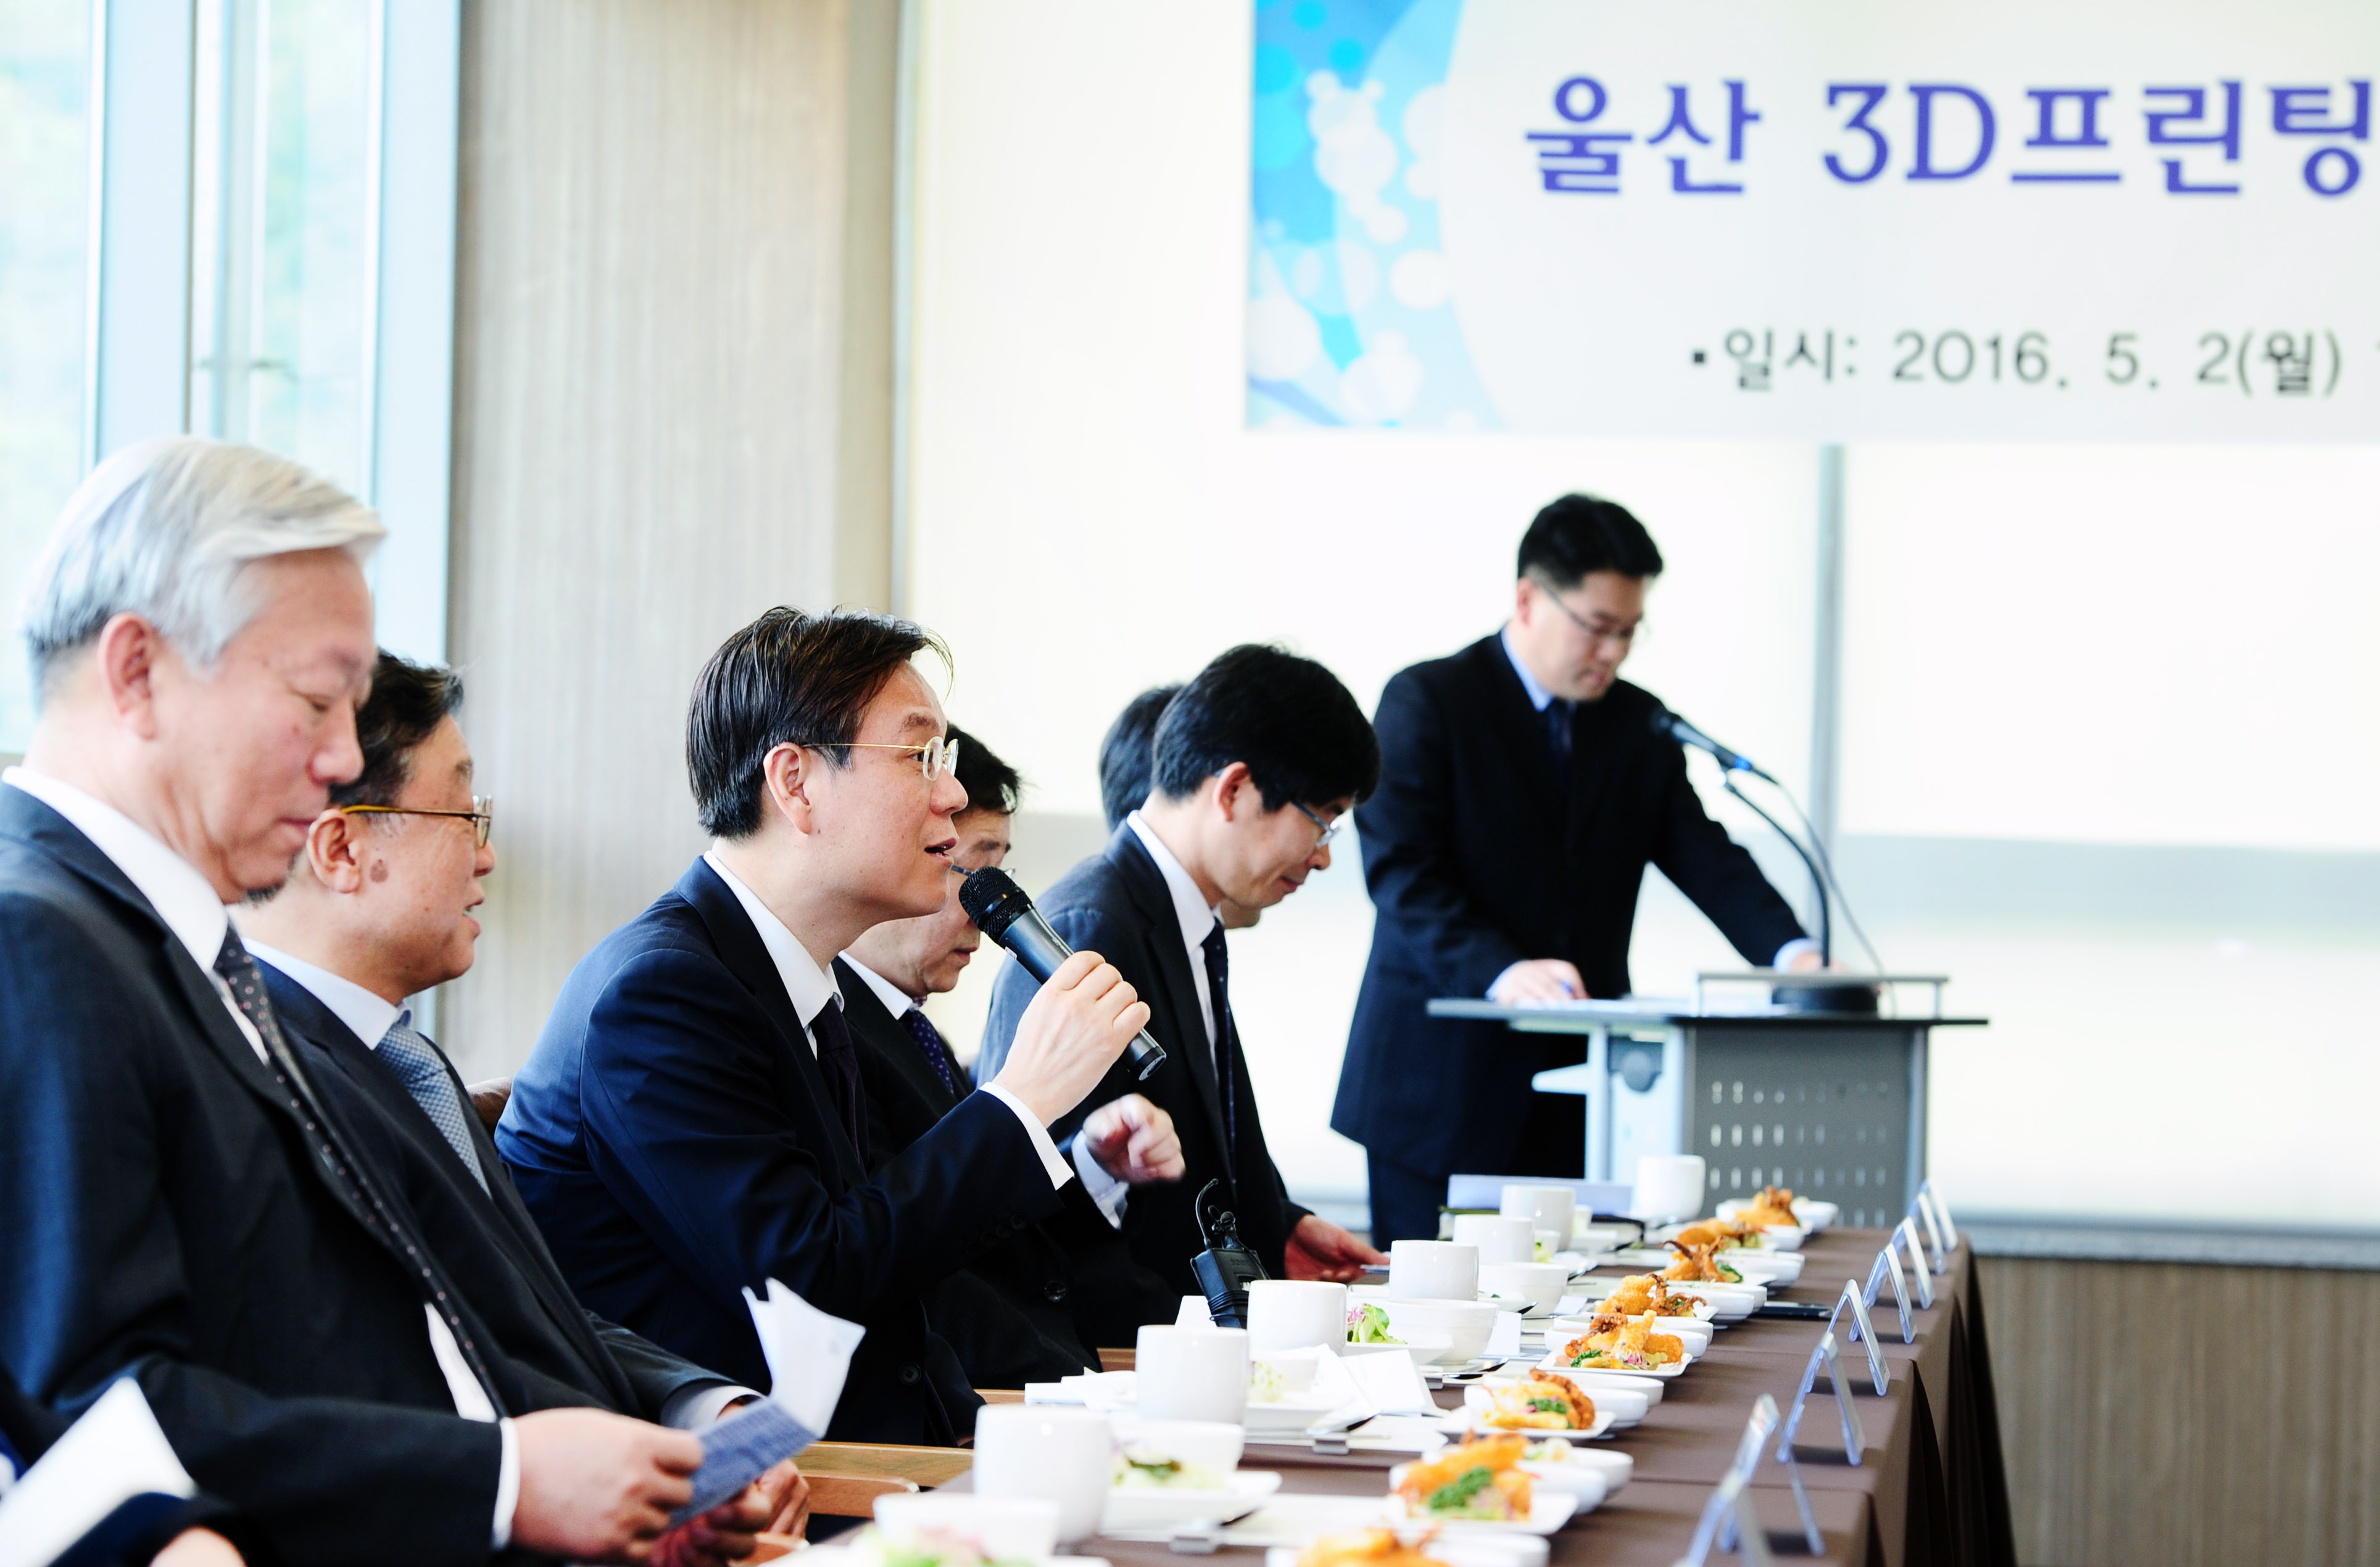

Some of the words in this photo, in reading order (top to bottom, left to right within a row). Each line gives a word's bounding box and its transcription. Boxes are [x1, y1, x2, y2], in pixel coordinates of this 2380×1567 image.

[1525, 75, 1762, 194] 울산
[1822, 80, 2372, 198] 3D프린팅
[1893, 331, 2067, 389] 2016.
[2107, 333, 2158, 389] 5.
[2197, 331, 2342, 396] 2(월)
